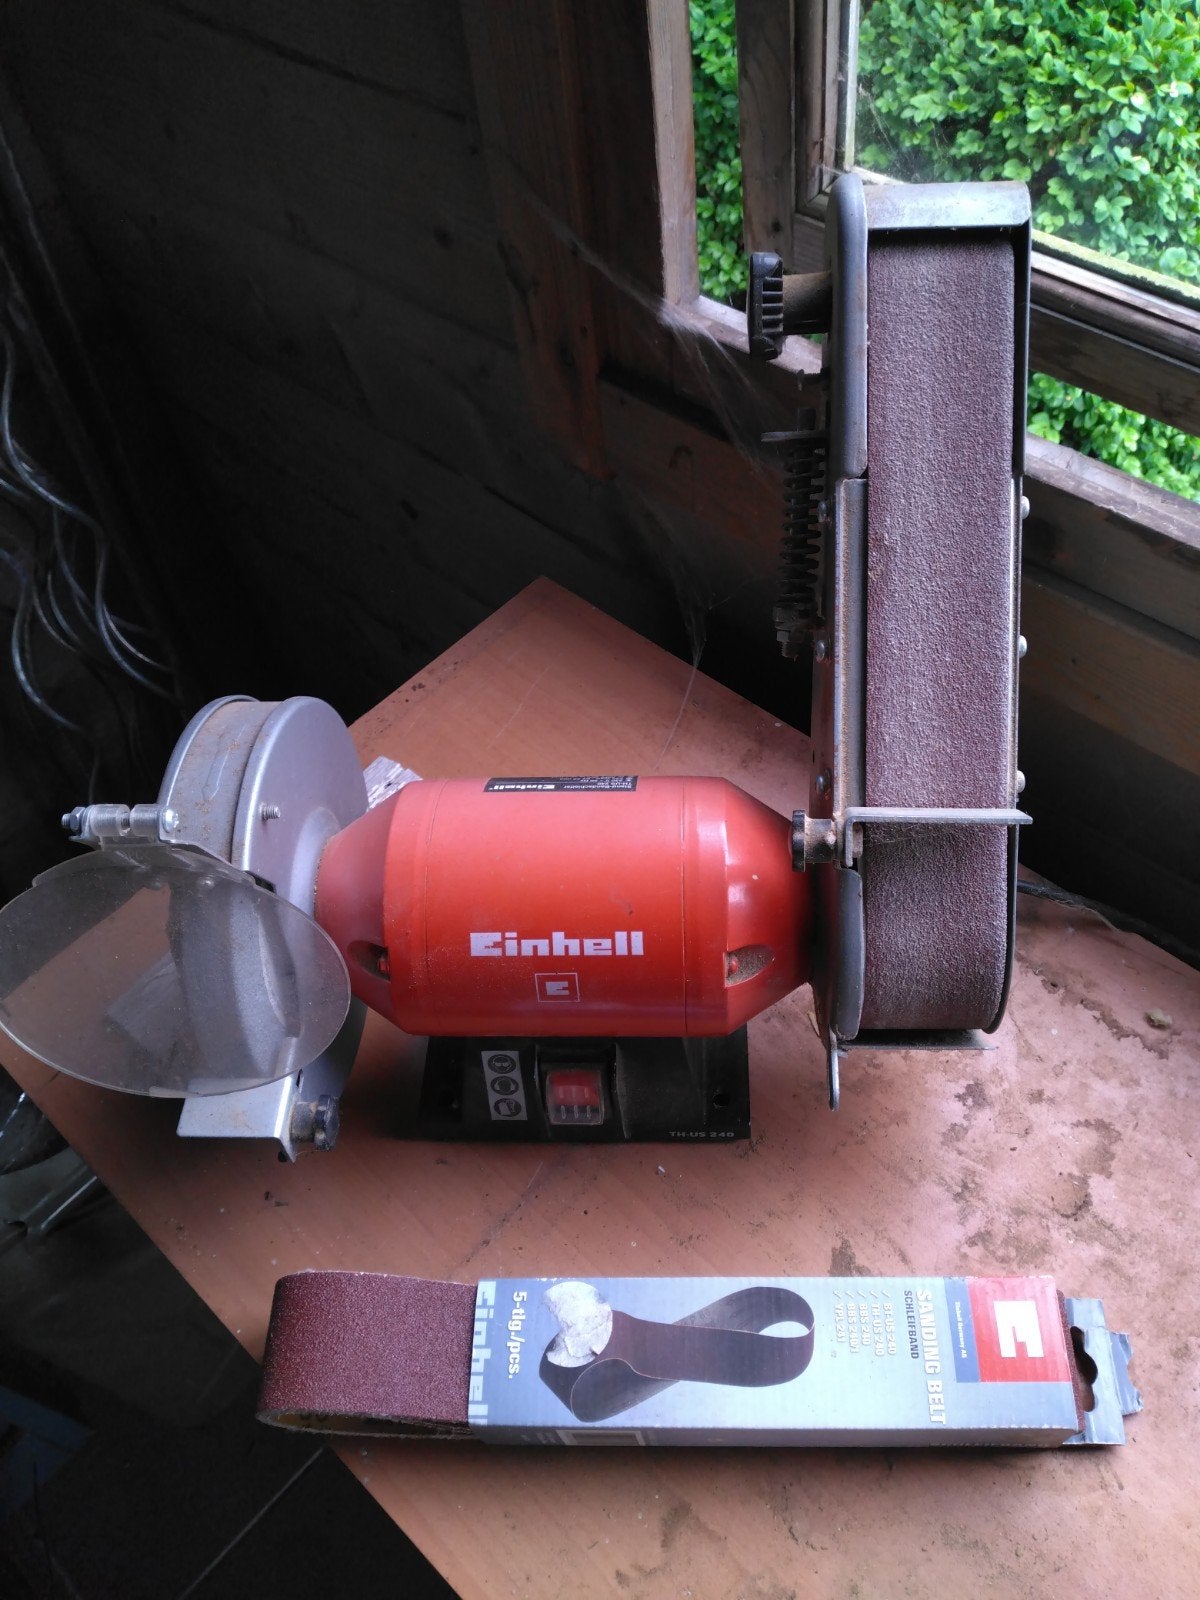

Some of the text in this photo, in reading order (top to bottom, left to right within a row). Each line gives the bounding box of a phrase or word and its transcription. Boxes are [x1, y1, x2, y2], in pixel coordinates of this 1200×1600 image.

[470, 931, 644, 957] Einhell
[507, 1291, 527, 1379] 5-tlg./pcs.
[861, 1327, 872, 1346] 240
[871, 1302, 885, 1357] TH-US 240
[886, 1334, 897, 1355] 240
[904, 1290, 919, 1360] SCHLEIFBAND
[916, 1288, 947, 1425] SANDING BELT
